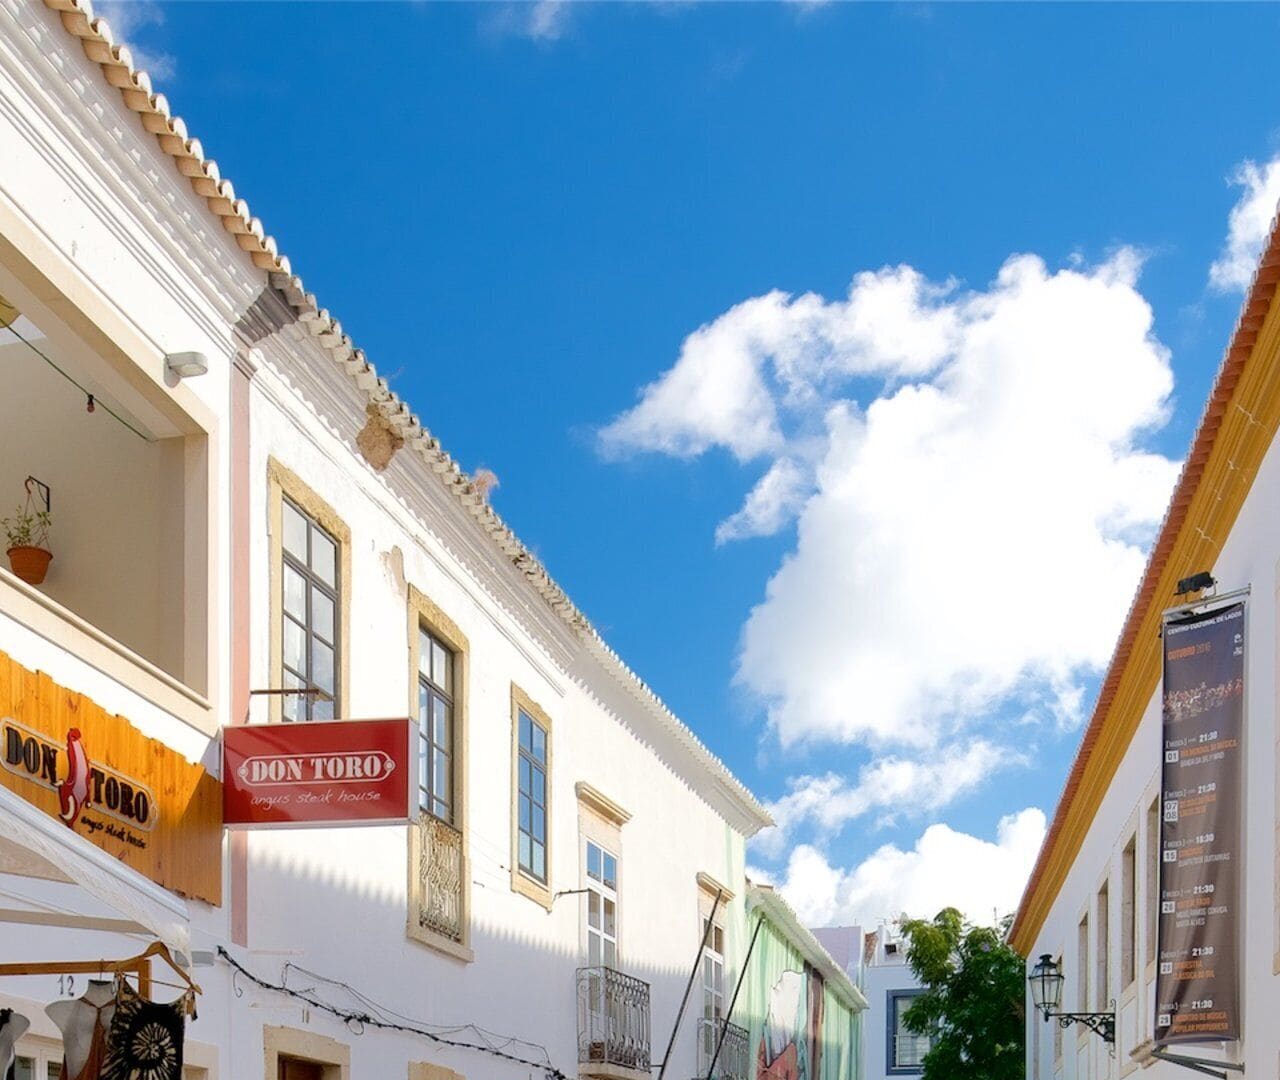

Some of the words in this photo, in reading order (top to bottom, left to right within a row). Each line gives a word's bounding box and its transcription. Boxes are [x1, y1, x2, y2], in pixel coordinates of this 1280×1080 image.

[6, 726, 58, 786] DON
[90, 767, 149, 824] TORO
[251, 758, 304, 782] DON
[310, 755, 382, 779] TORO
[250, 794, 290, 811] angus
[298, 788, 333, 803] steak
[338, 790, 381, 803] house
[1166, 802, 1177, 810] 07
[1193, 884, 1215, 894] 21:30
[1192, 946, 1214, 956] 21:30
[56, 974, 75, 997] 12
[1192, 1000, 1213, 1009] 21:30
